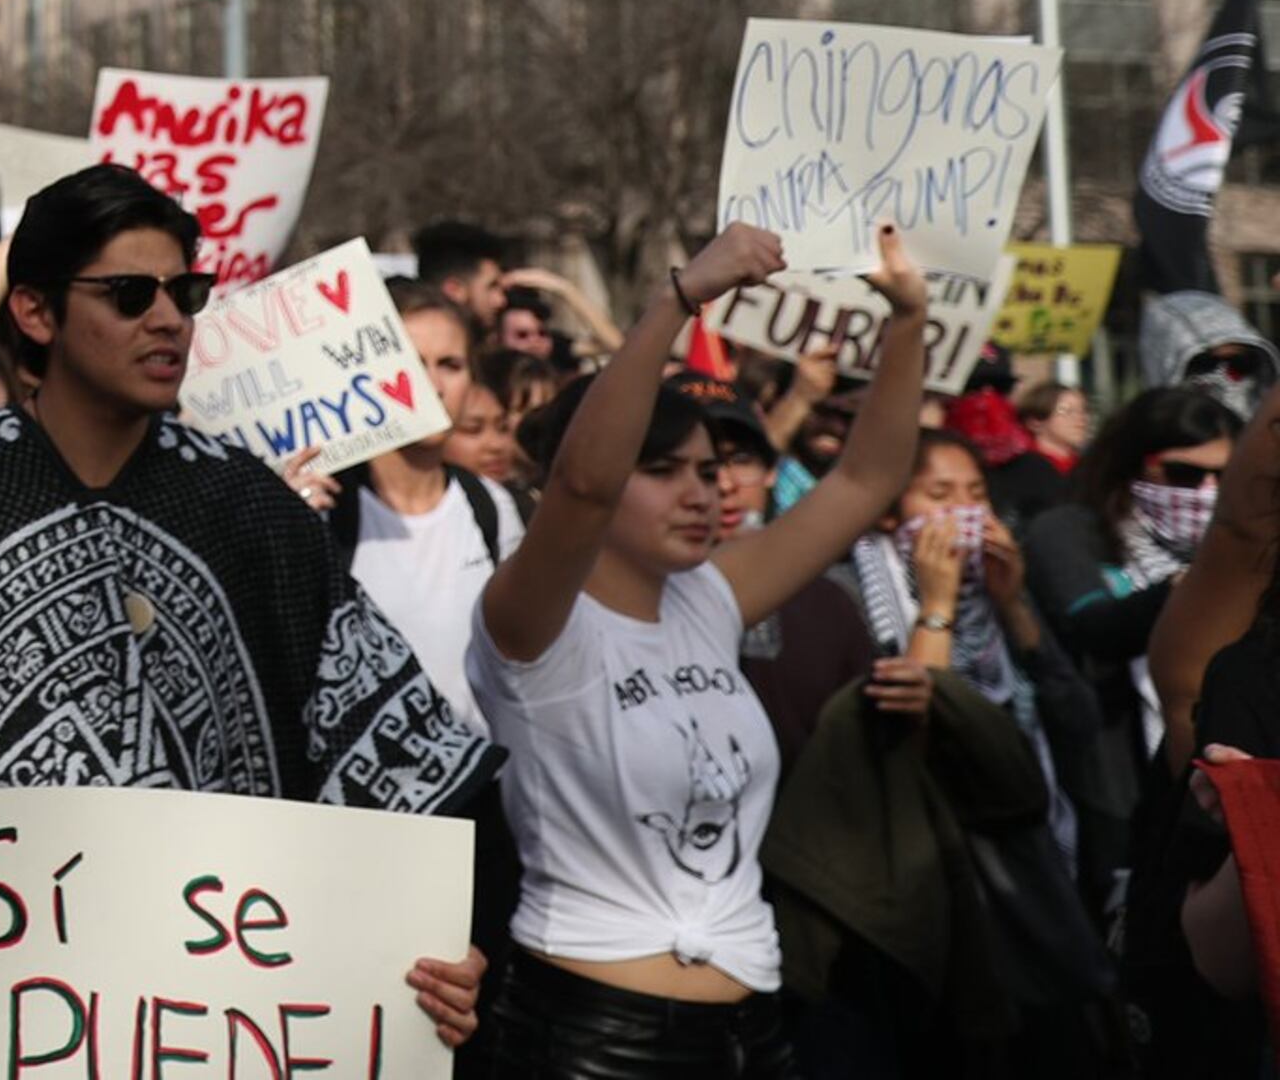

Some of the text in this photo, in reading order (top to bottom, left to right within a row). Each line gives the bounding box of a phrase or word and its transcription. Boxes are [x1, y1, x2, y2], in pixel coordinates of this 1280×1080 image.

[98, 80, 308, 146] Amerika
[102, 152, 237, 196] as
[190, 314, 402, 420] WILL WIN
[191, 278, 326, 369] OVE
[213, 373, 385, 457] WAYS
[180, 874, 294, 969] se
